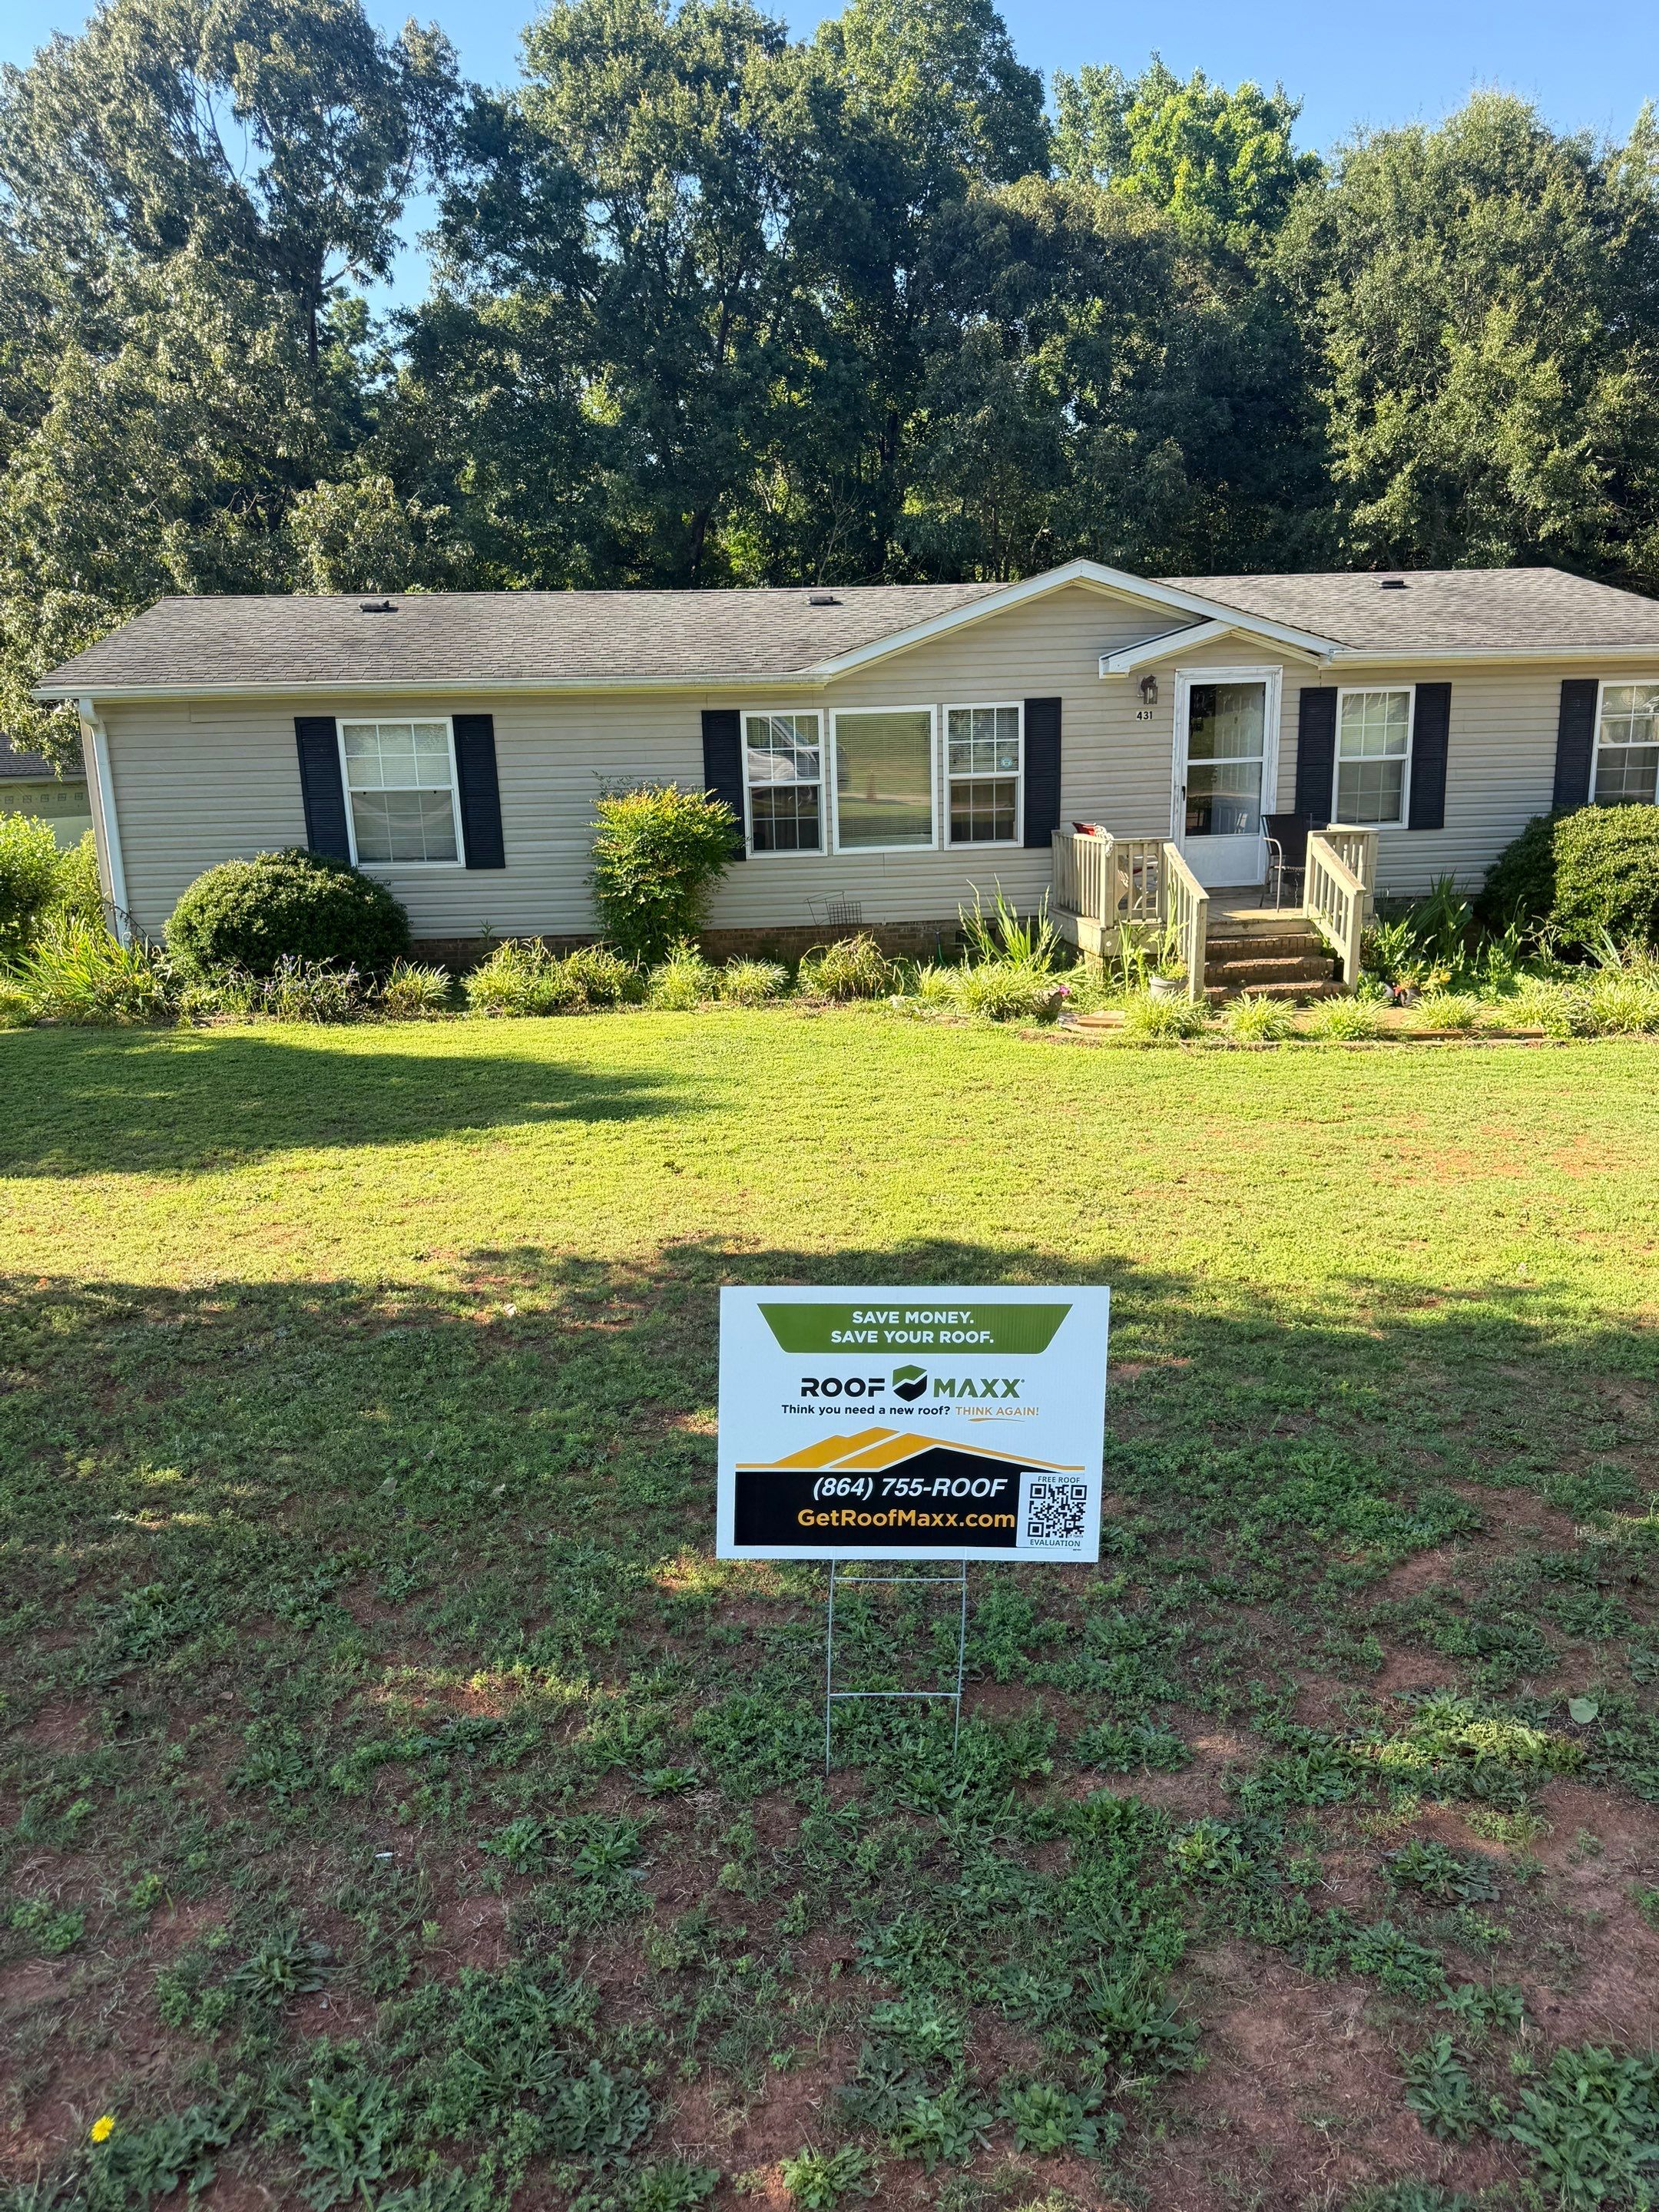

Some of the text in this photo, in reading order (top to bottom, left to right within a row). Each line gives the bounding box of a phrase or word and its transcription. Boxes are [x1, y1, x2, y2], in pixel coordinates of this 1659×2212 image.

[1137, 711, 1153, 720] 431
[852, 1311, 975, 1324] SAVE MONEY.
[830, 1330, 995, 1343] SAVE YOUR ROOF.
[800, 1377, 1021, 1399] ROOF MAXX
[781, 1404, 815, 1414] Think
[819, 1406, 841, 1416] you
[844, 1405, 875, 1415] need
[918, 1406, 951, 1416] roof?
[955, 1406, 993, 1416] THINK
[995, 1407, 1040, 1416] AGAIN!
[813, 1477, 1008, 1501] (864) 755-ROOF
[797, 1508, 1015, 1528] GetRoofMaxx.com
